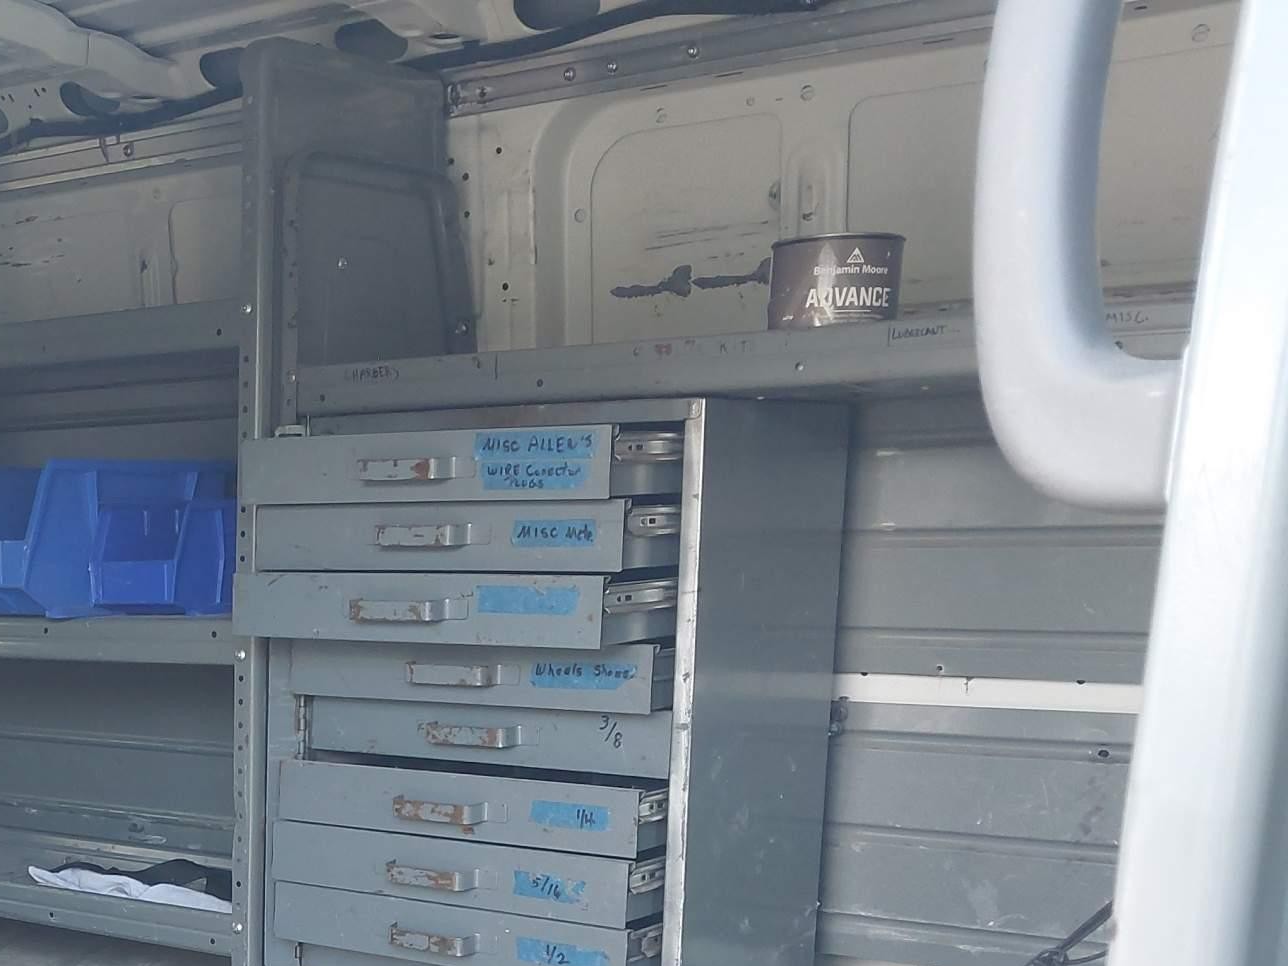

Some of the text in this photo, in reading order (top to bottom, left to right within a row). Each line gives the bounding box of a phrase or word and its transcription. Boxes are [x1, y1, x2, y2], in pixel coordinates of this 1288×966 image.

[813, 264, 889, 276] Benjamin Moore
[805, 286, 892, 308] ADVANCE
[482, 437, 521, 453] MISC
[486, 463, 521, 477] WIRE
[516, 525, 559, 539] MISC
[598, 714, 624, 749] 3/8
[545, 943, 570, 965] 1/2
